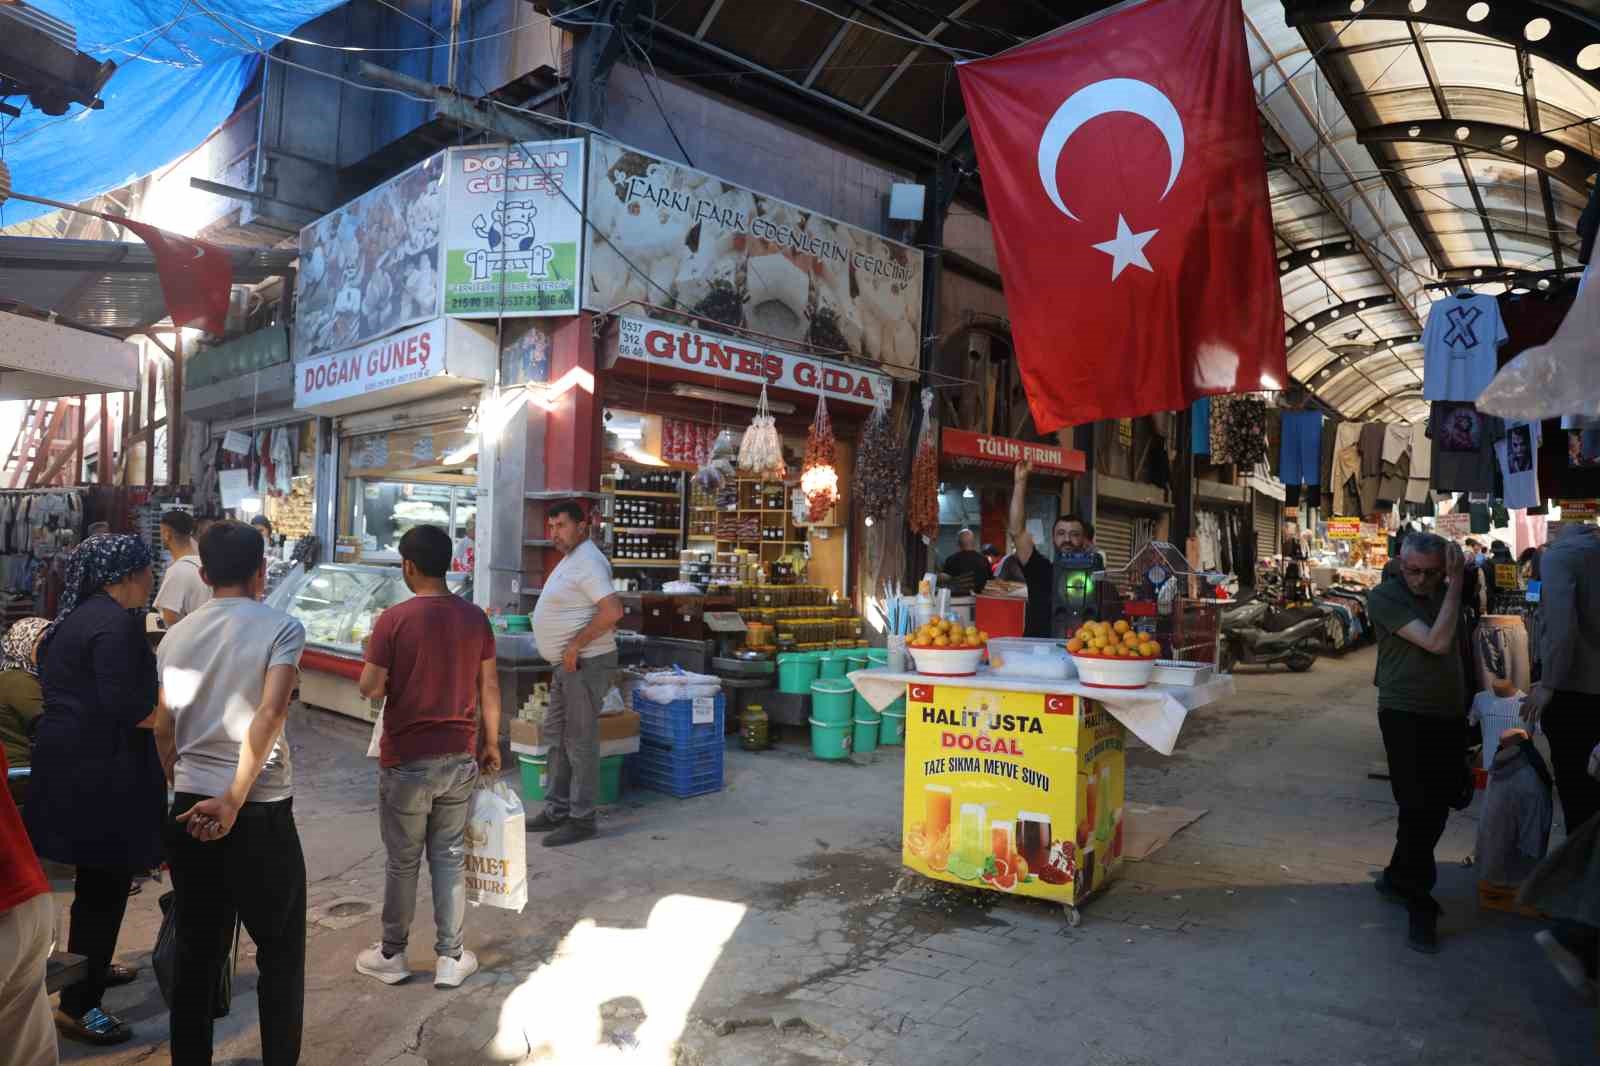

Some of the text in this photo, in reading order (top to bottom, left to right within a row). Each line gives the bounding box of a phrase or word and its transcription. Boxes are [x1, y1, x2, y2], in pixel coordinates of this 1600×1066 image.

[463, 151, 569, 173] DOĞAN
[467, 173, 564, 197] GÜNEŞ
[627, 178, 690, 212] FARKI
[695, 199, 744, 231] FARK
[752, 218, 849, 262] EDENLERİN
[621, 320, 643, 332] 0537
[623, 333, 640, 345] 312
[304, 355, 361, 394] DOĞAN
[645, 330, 783, 385] GÜNEŞ
[793, 361, 874, 399] GIDA
[976, 438, 1020, 459] TÜLİN
[922, 706, 1043, 734] HALİT USTA
[941, 729, 1024, 756] DOĞAL
[924, 757, 1050, 792] TAZE SIKMA MEYVE SUYU
